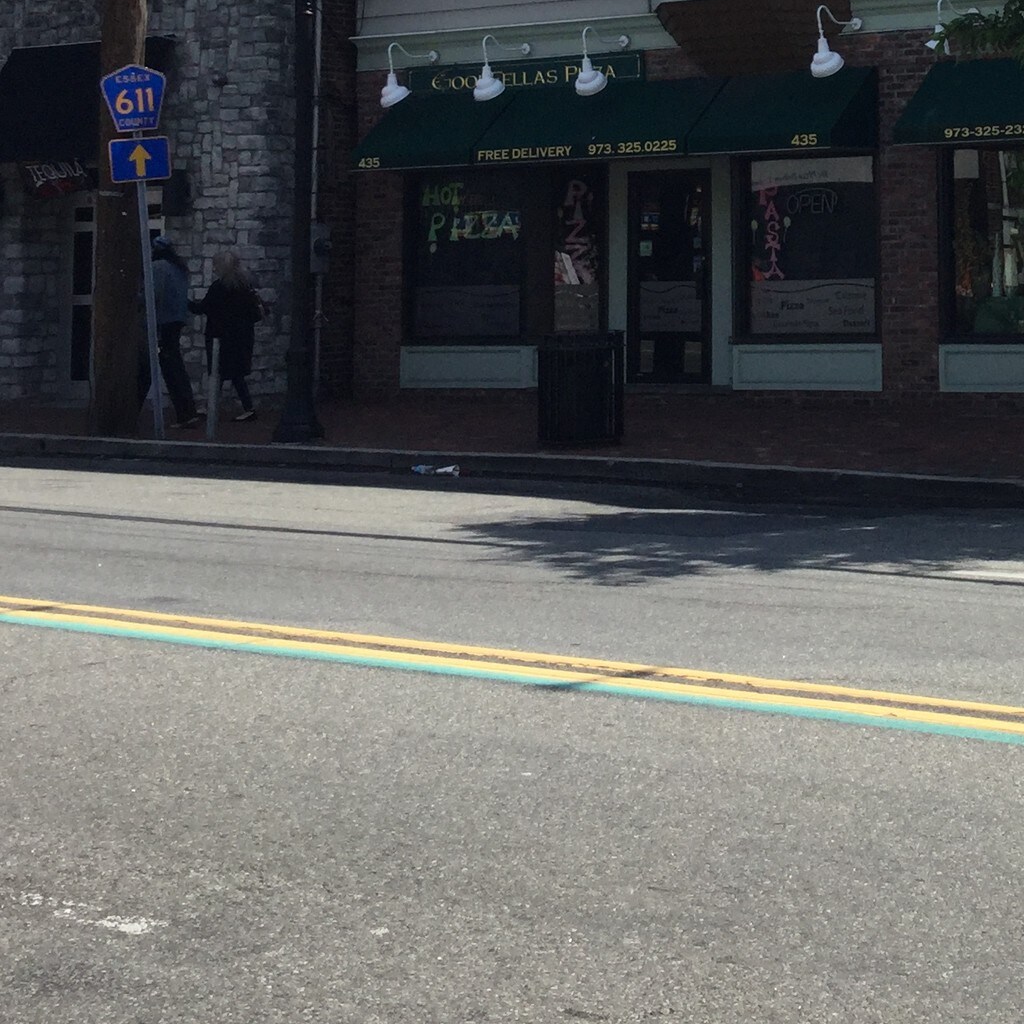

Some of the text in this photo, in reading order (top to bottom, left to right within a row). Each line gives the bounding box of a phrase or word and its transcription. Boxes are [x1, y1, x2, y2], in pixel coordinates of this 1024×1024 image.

[115, 87, 154, 115] 611
[118, 117, 155, 127] COUNTY
[791, 133, 818, 145] 435
[358, 157, 380, 168] 435
[478, 148, 511, 161] FREE
[512, 145, 572, 159] DELIVERY
[25, 160, 88, 183] TEQUILA
[422, 182, 464, 209] HOT
[787, 193, 834, 215] OPEN
[427, 209, 520, 243] PIZZA
[757, 183, 785, 280] PASTA
